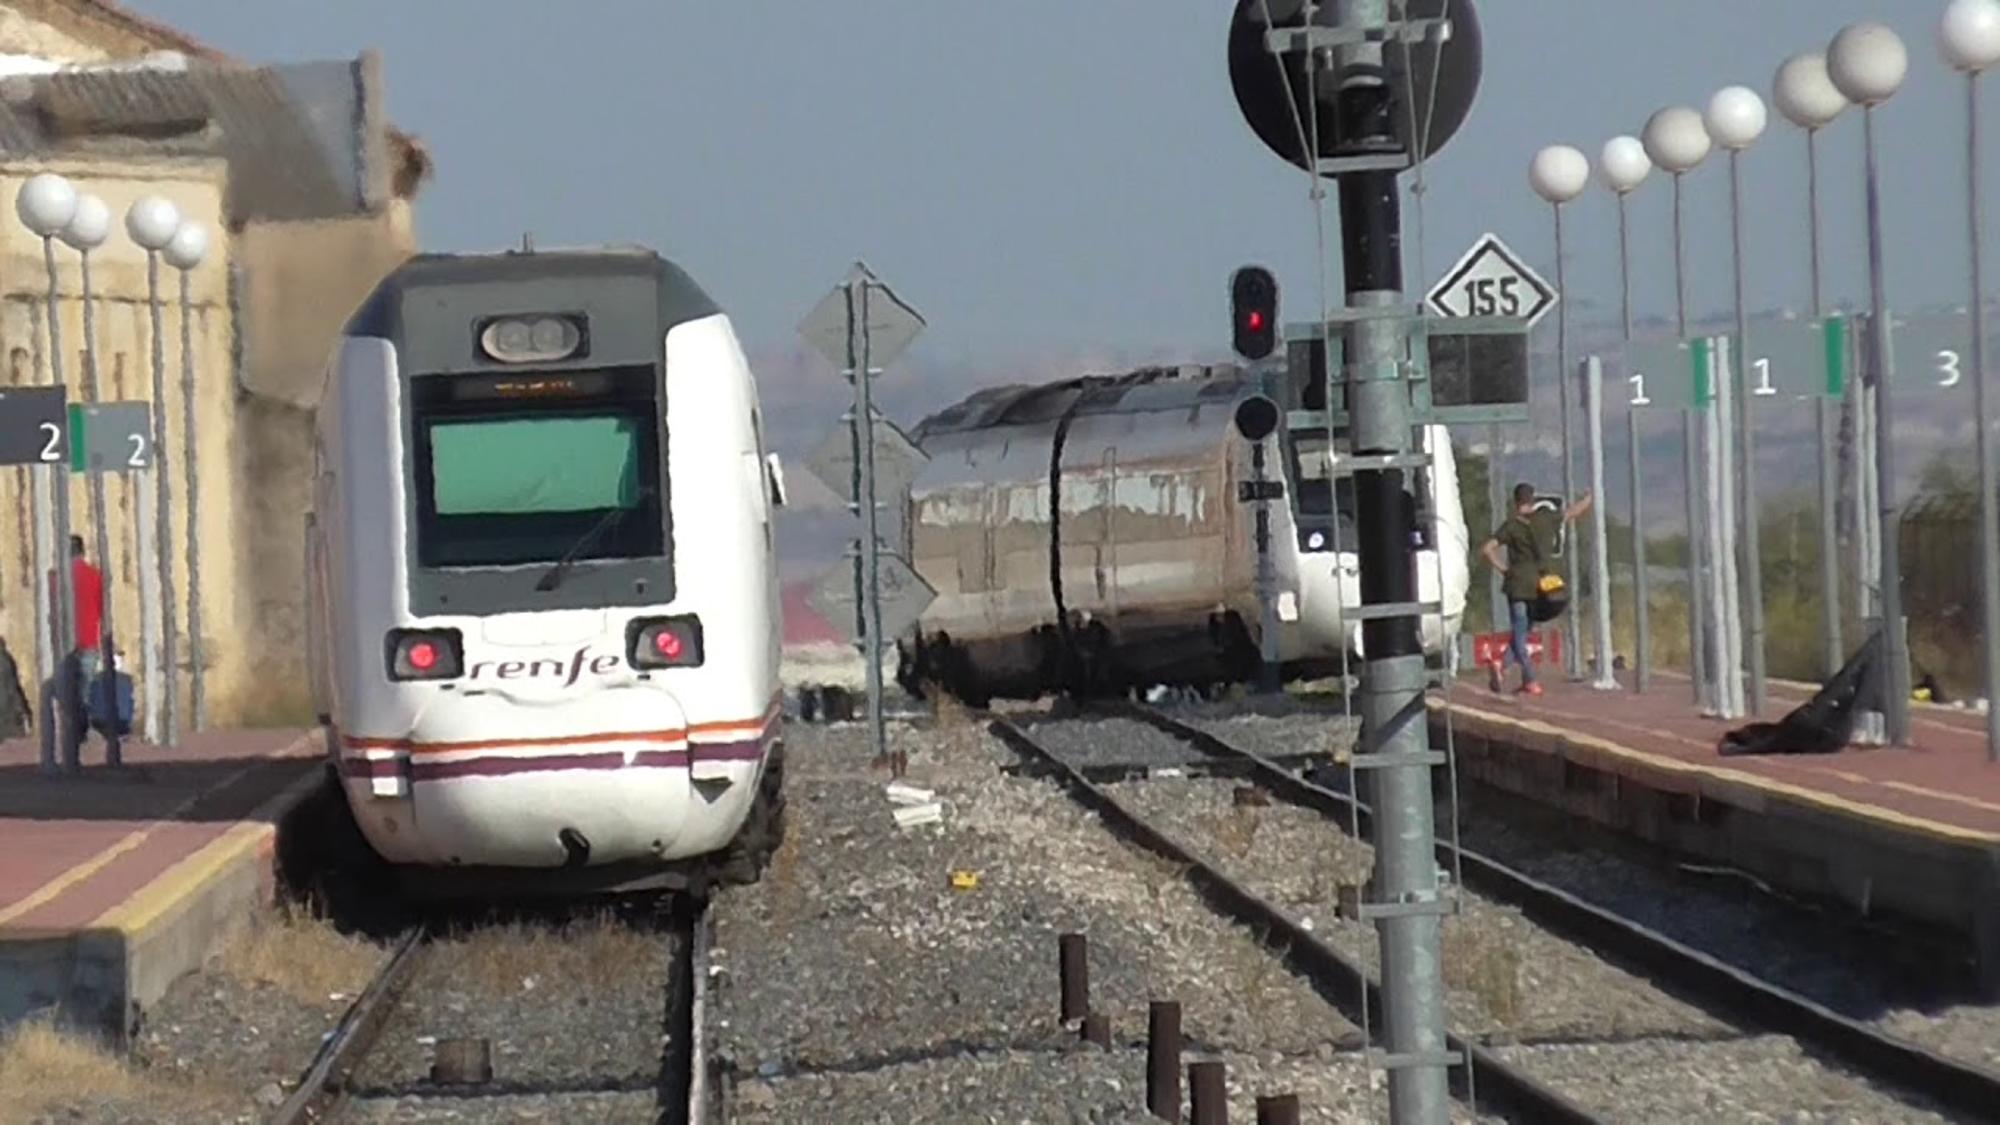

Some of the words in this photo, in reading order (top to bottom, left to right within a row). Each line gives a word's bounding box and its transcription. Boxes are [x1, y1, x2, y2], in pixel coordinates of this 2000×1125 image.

[1465, 276, 1519, 316] 155
[1753, 358, 1776, 394] 1
[1938, 350, 1959, 386] 3
[1629, 374, 1650, 404] 1
[39, 422, 60, 461] 2
[127, 433, 146, 466] 2
[470, 645, 619, 688] renfe
